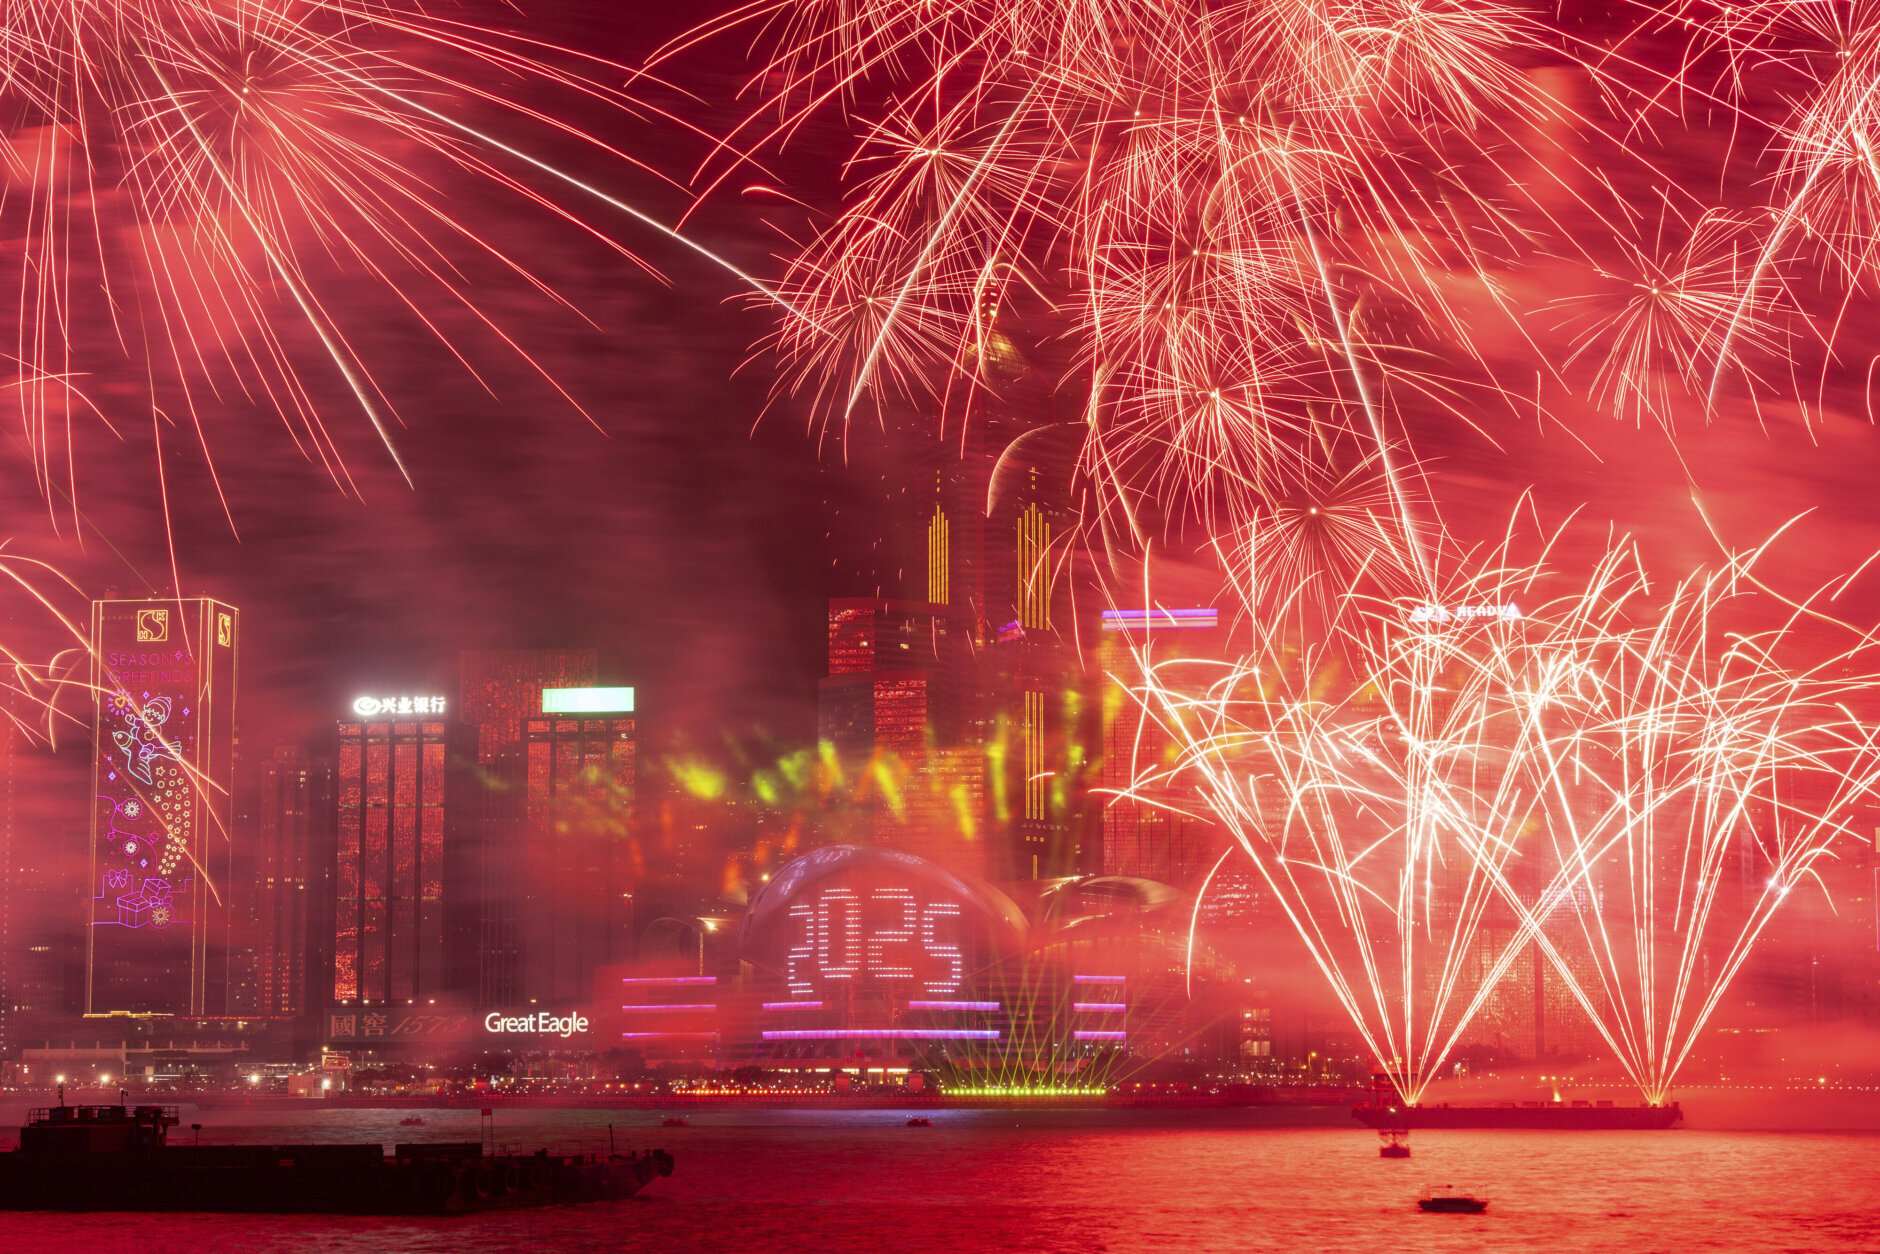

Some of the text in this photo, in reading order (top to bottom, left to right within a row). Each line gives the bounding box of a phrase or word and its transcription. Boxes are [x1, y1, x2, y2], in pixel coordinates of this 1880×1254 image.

[108, 670, 191, 683] GREETINGS
[381, 696, 446, 714] 兴业银行
[788, 889, 963, 993] 2025
[485, 1011, 589, 1038] Great Eagle
